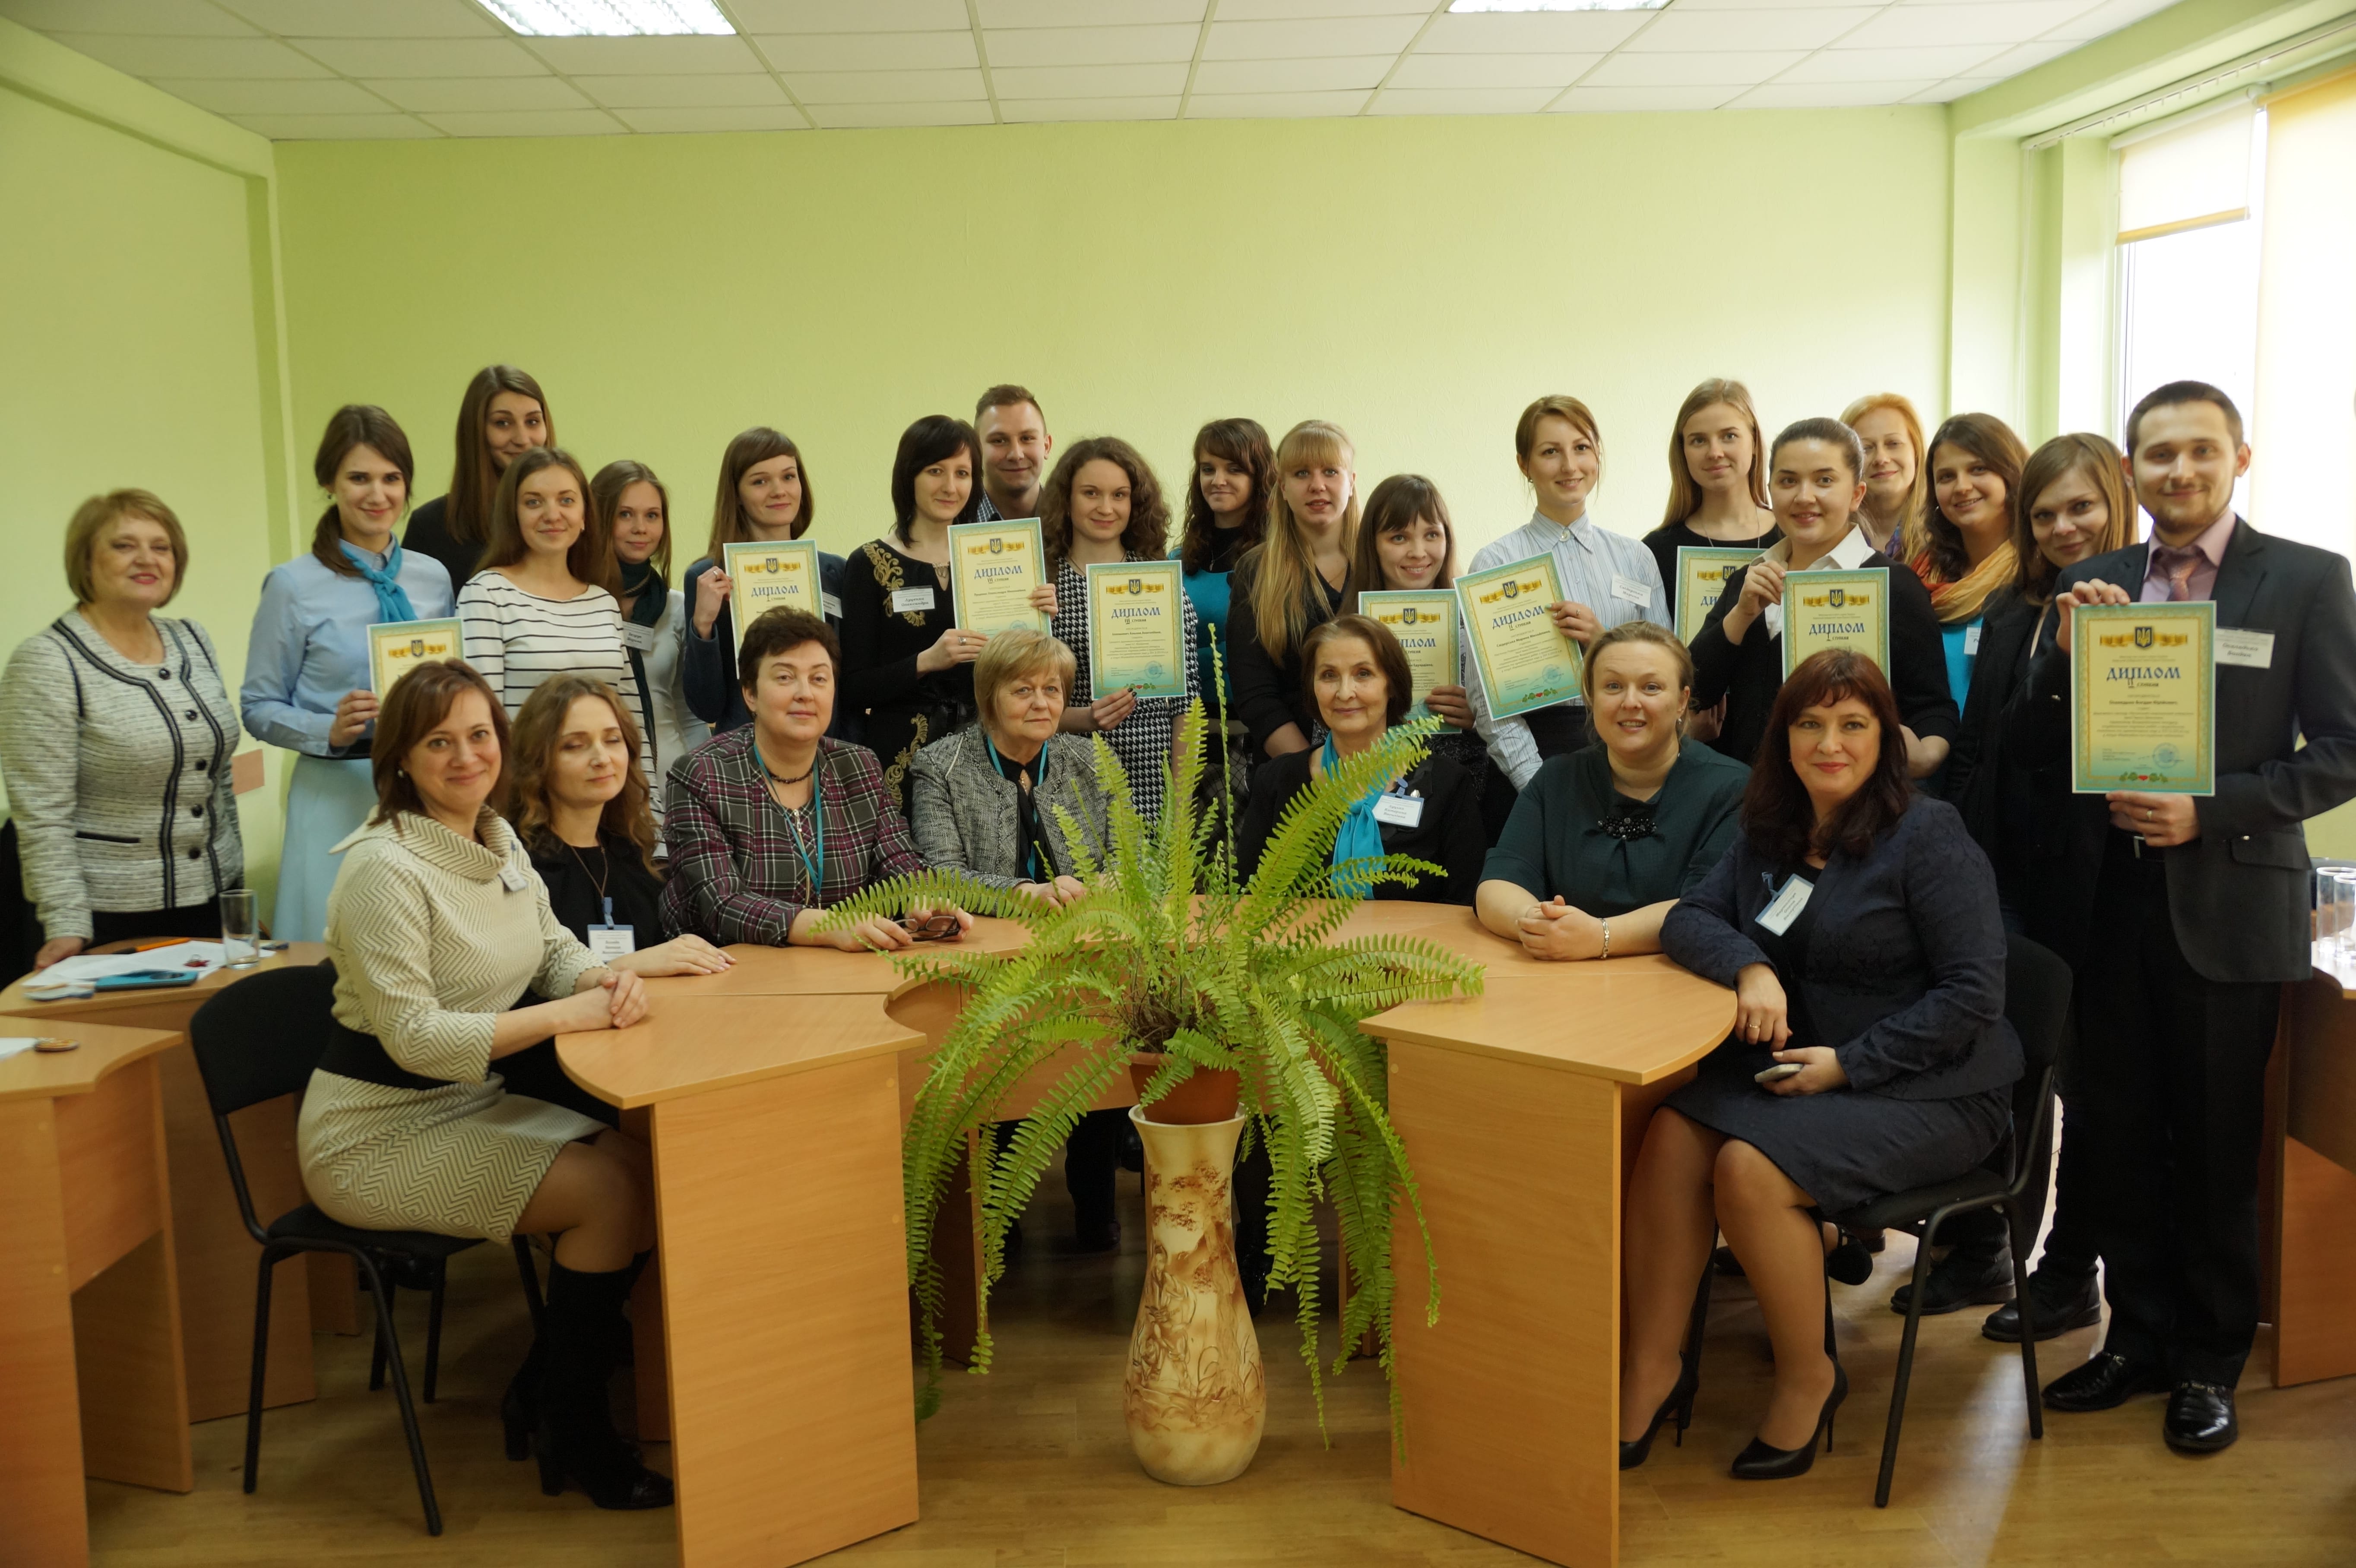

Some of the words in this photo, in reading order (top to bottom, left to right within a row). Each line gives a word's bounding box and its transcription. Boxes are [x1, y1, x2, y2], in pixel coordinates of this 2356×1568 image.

[974, 565, 1023, 579] ДИПЛОМ
[751, 585, 799, 597] ДИПЛОМ
[1112, 607, 1161, 619] ДИПЛОМ
[1492, 605, 1545, 630] ДИПЛОМ
[1809, 623, 1865, 636] ДИПЛОМ
[1400, 638, 1436, 648] ПЛОМ
[2106, 667, 2181, 682] ДИПЛОМ
